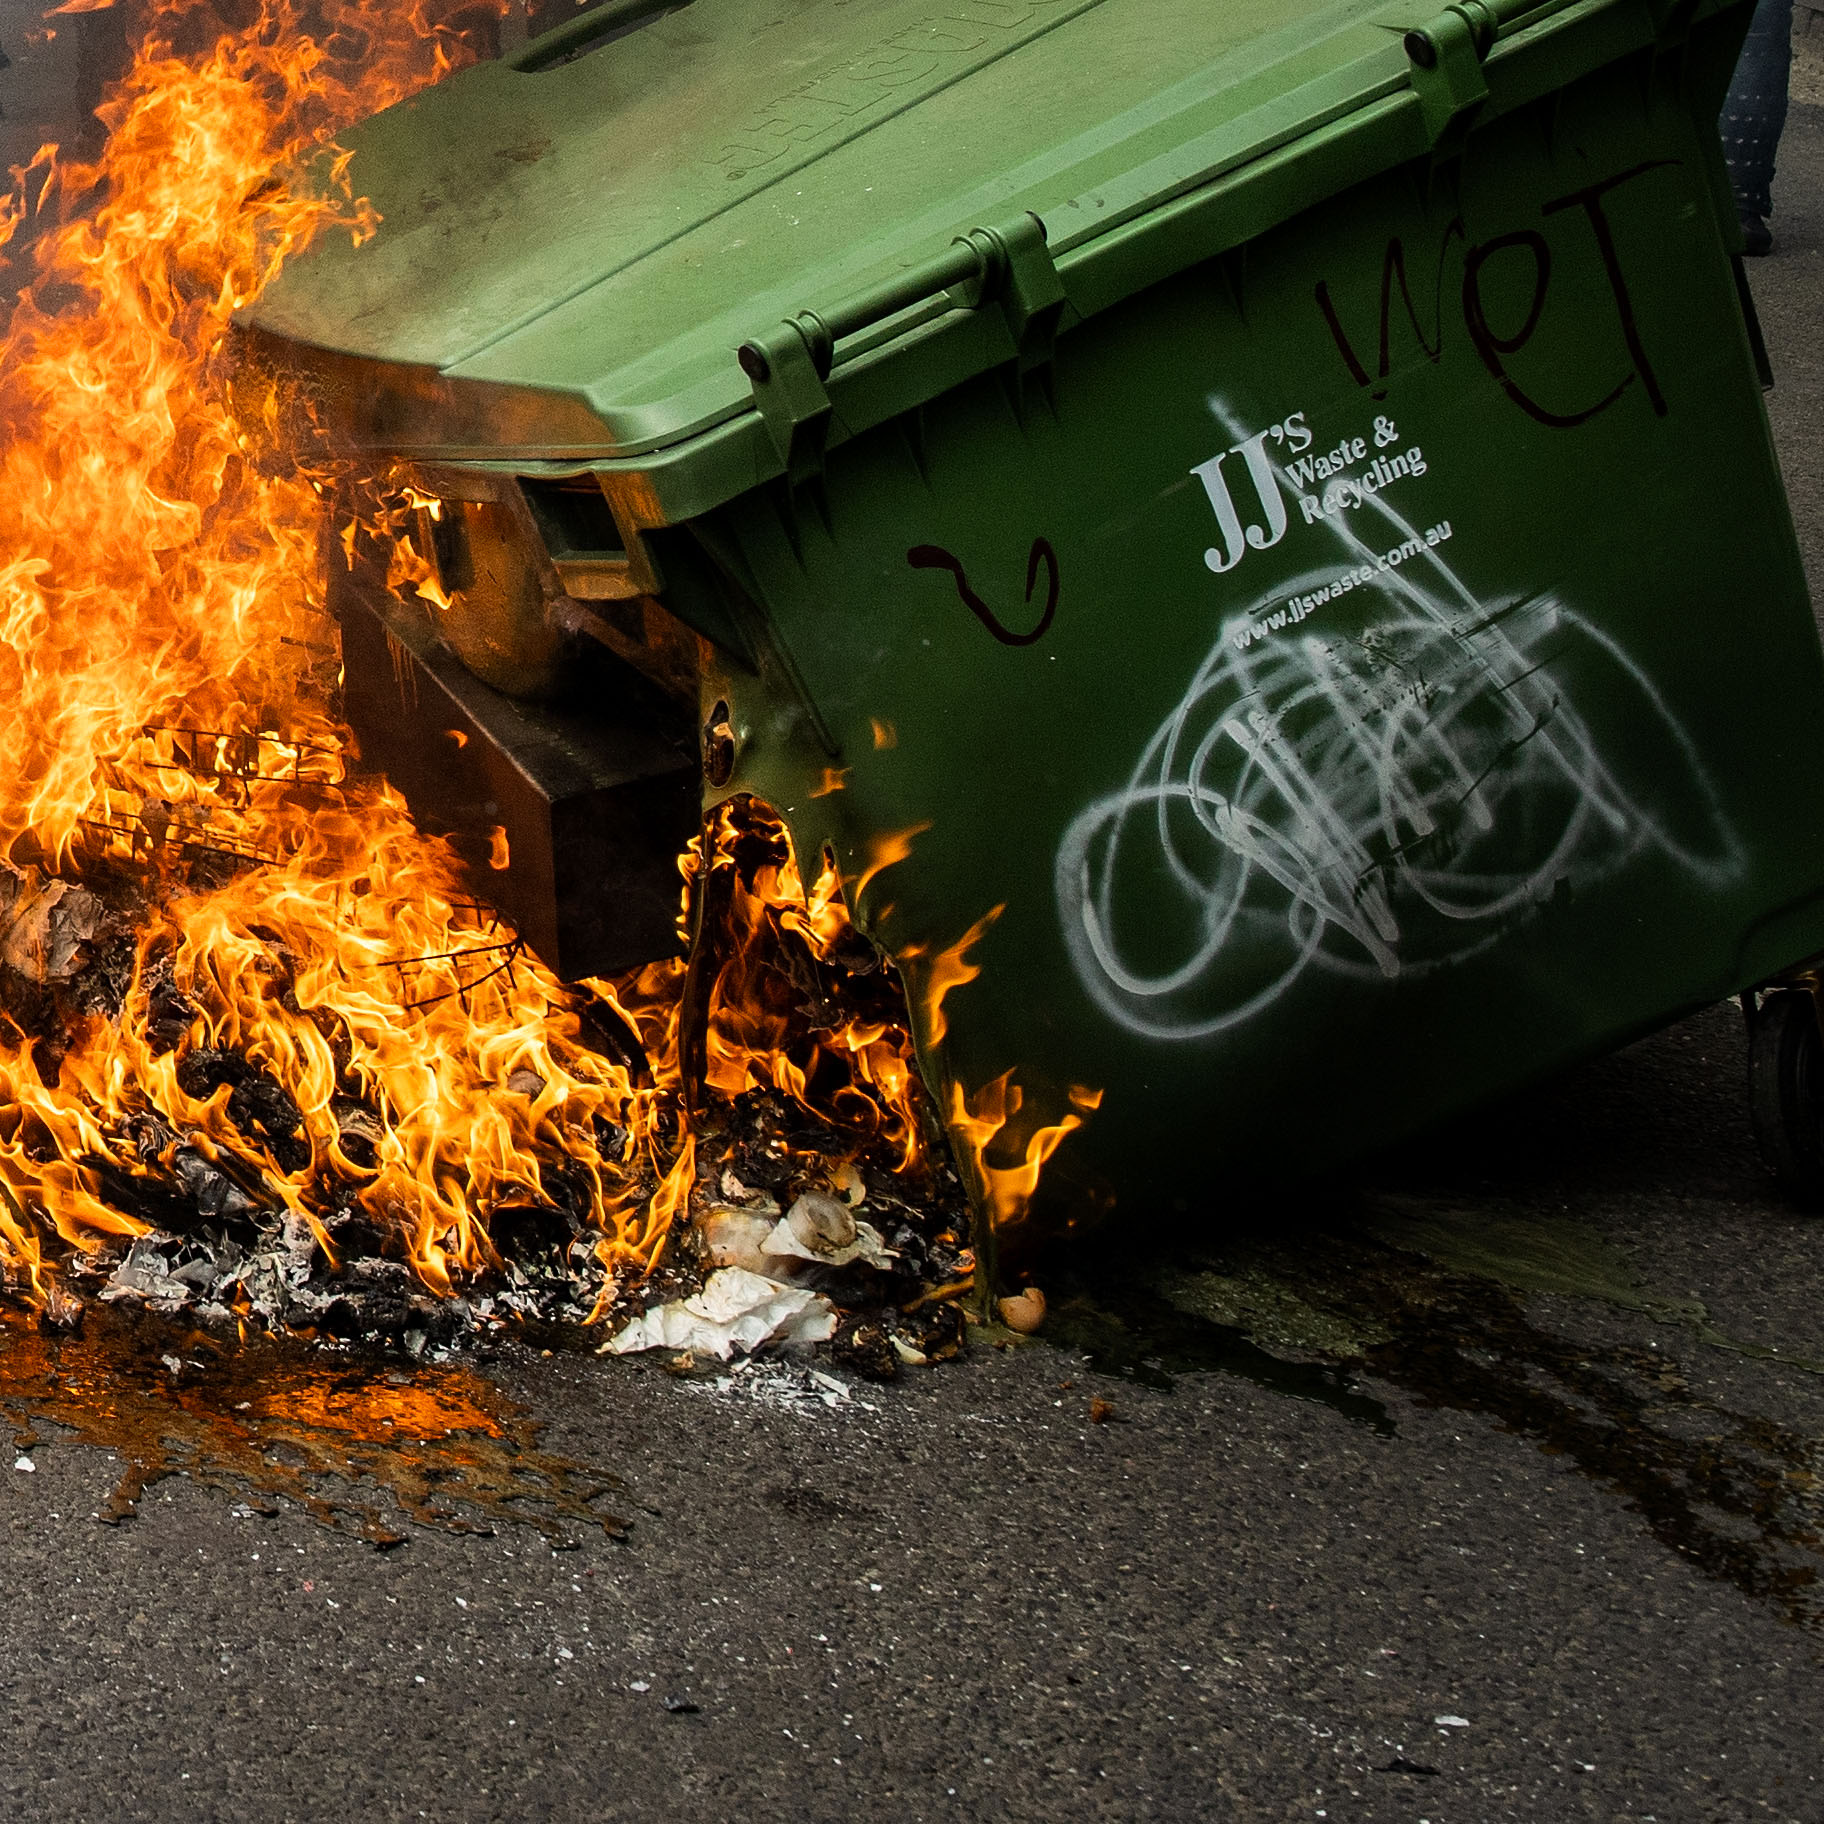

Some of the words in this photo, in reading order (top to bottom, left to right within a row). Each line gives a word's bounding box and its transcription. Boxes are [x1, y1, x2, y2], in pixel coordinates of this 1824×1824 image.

[1285, 437, 1366, 488] Waste
[1373, 415, 1399, 447] &
[1299, 446, 1427, 524] Recycling
[1232, 521, 1452, 650] www.jjswaste.com.au
